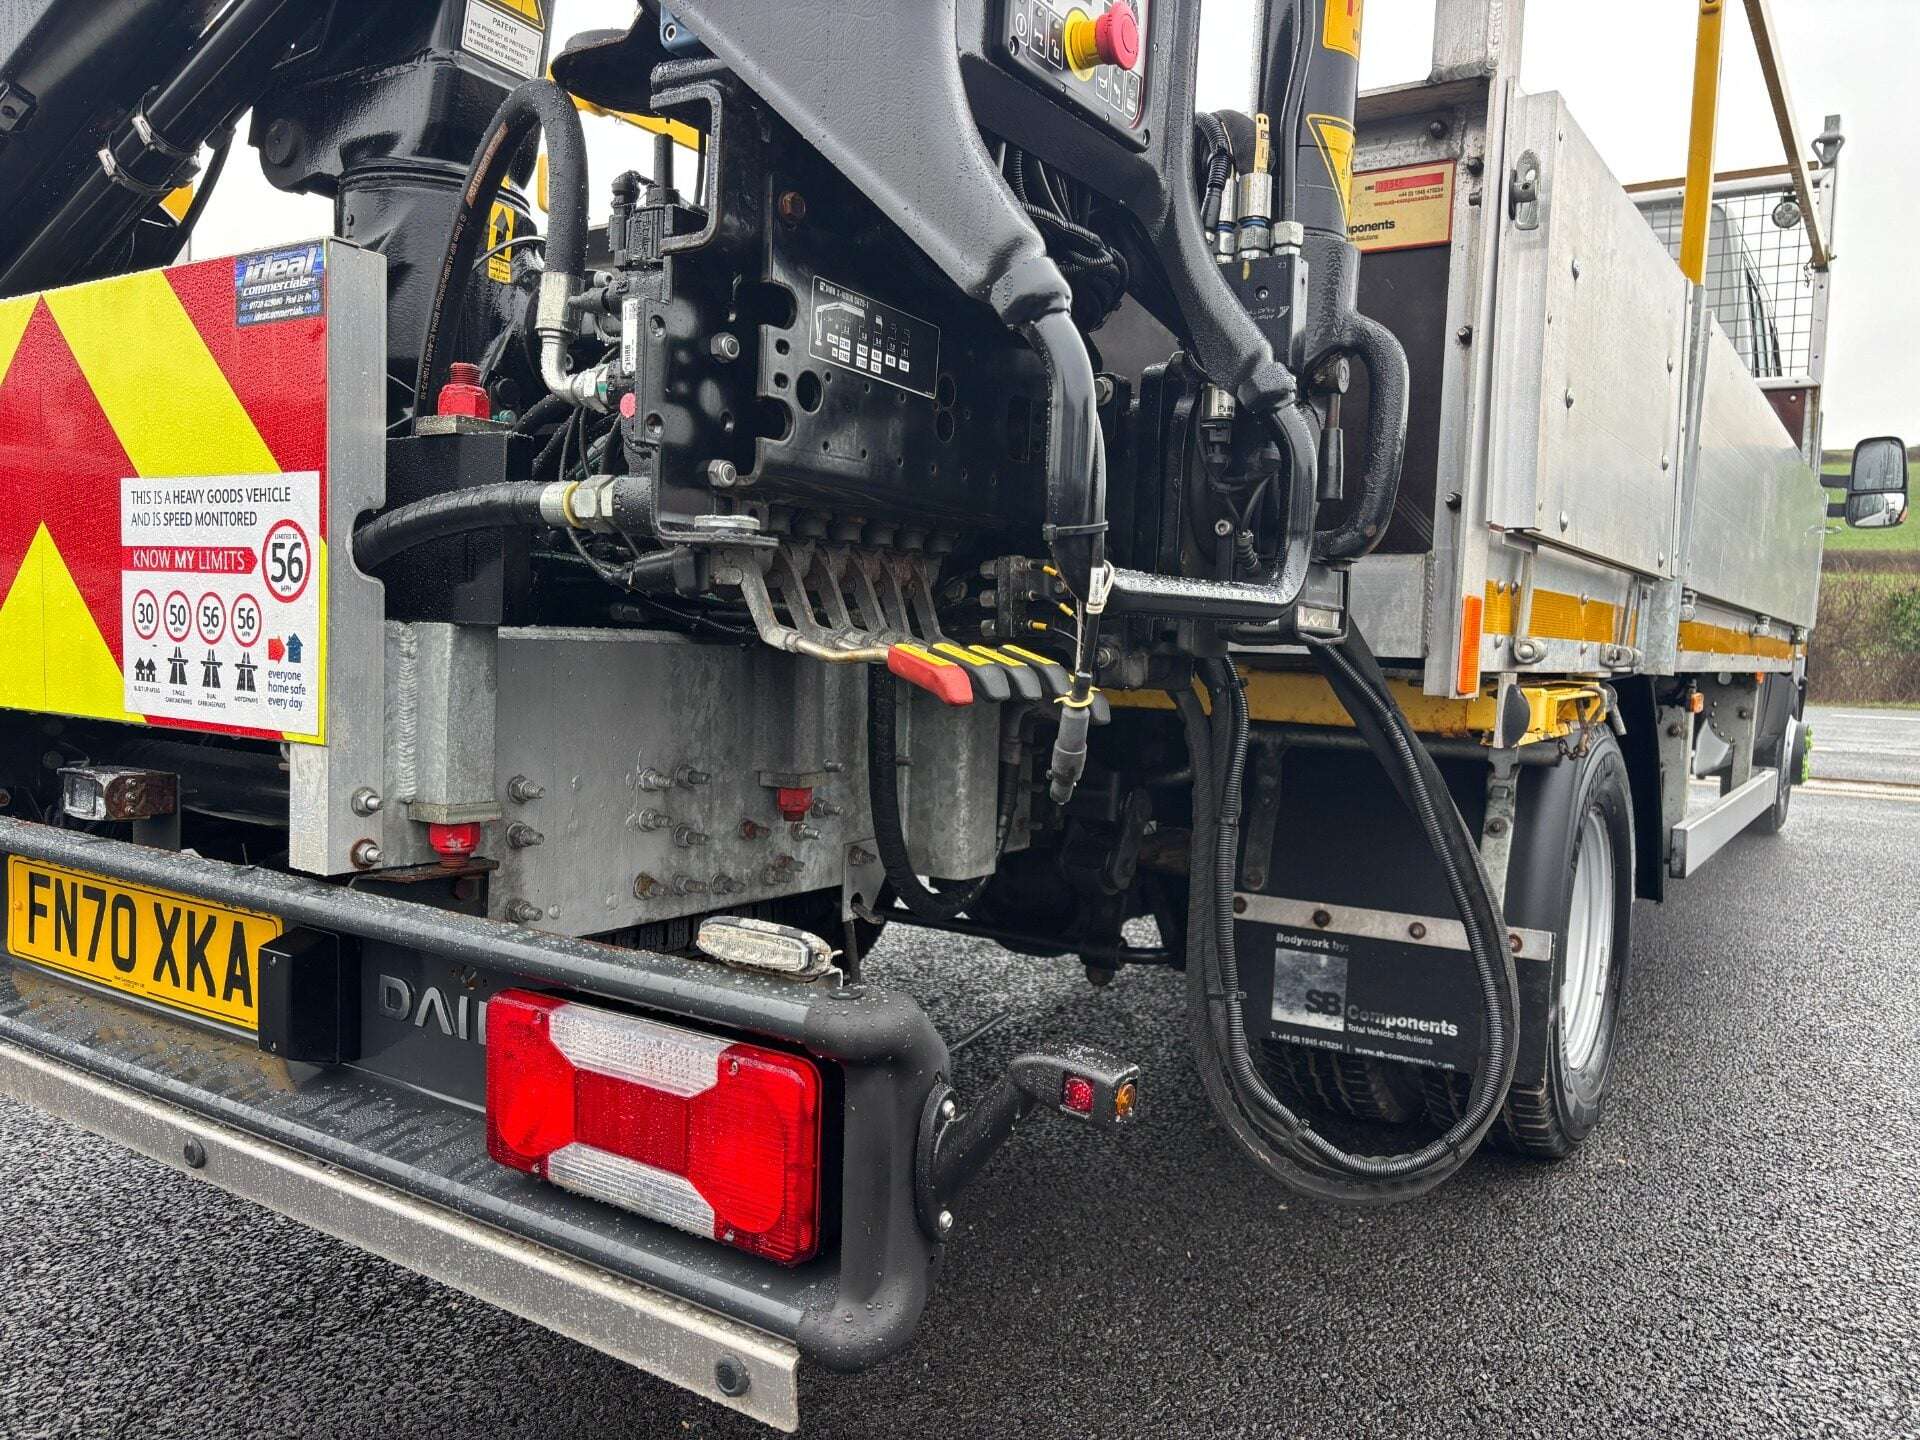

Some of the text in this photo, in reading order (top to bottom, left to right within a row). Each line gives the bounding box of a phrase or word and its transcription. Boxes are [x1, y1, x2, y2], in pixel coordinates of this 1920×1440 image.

[492, 17, 518, 36] PATENT
[243, 247, 317, 287] ideal
[242, 276, 309, 297] commercials
[130, 487, 291, 505] THIS IS A HEAVY GOODS VEHICLE
[130, 511, 258, 527] AND IS SPEED MONITORED
[132, 549, 246, 571] KNOW MY LIMITS
[270, 541, 304, 584] 56
[280, 584, 292, 593] MPH
[137, 602, 154, 625] 30
[169, 604, 187, 627] 50
[202, 606, 220, 629] 56
[237, 607, 255, 631] 56
[267, 669, 302, 683] everyone
[267, 683, 306, 696] home safe
[267, 697, 303, 712] every day
[28, 871, 254, 1008] FN70 XKA
[1275, 932, 1330, 949] Bodywork
[1304, 989, 1342, 1017] SB
[1347, 1004, 1459, 1038] Components
[1347, 1023, 1434, 1046] Total Vehicle Solutions
